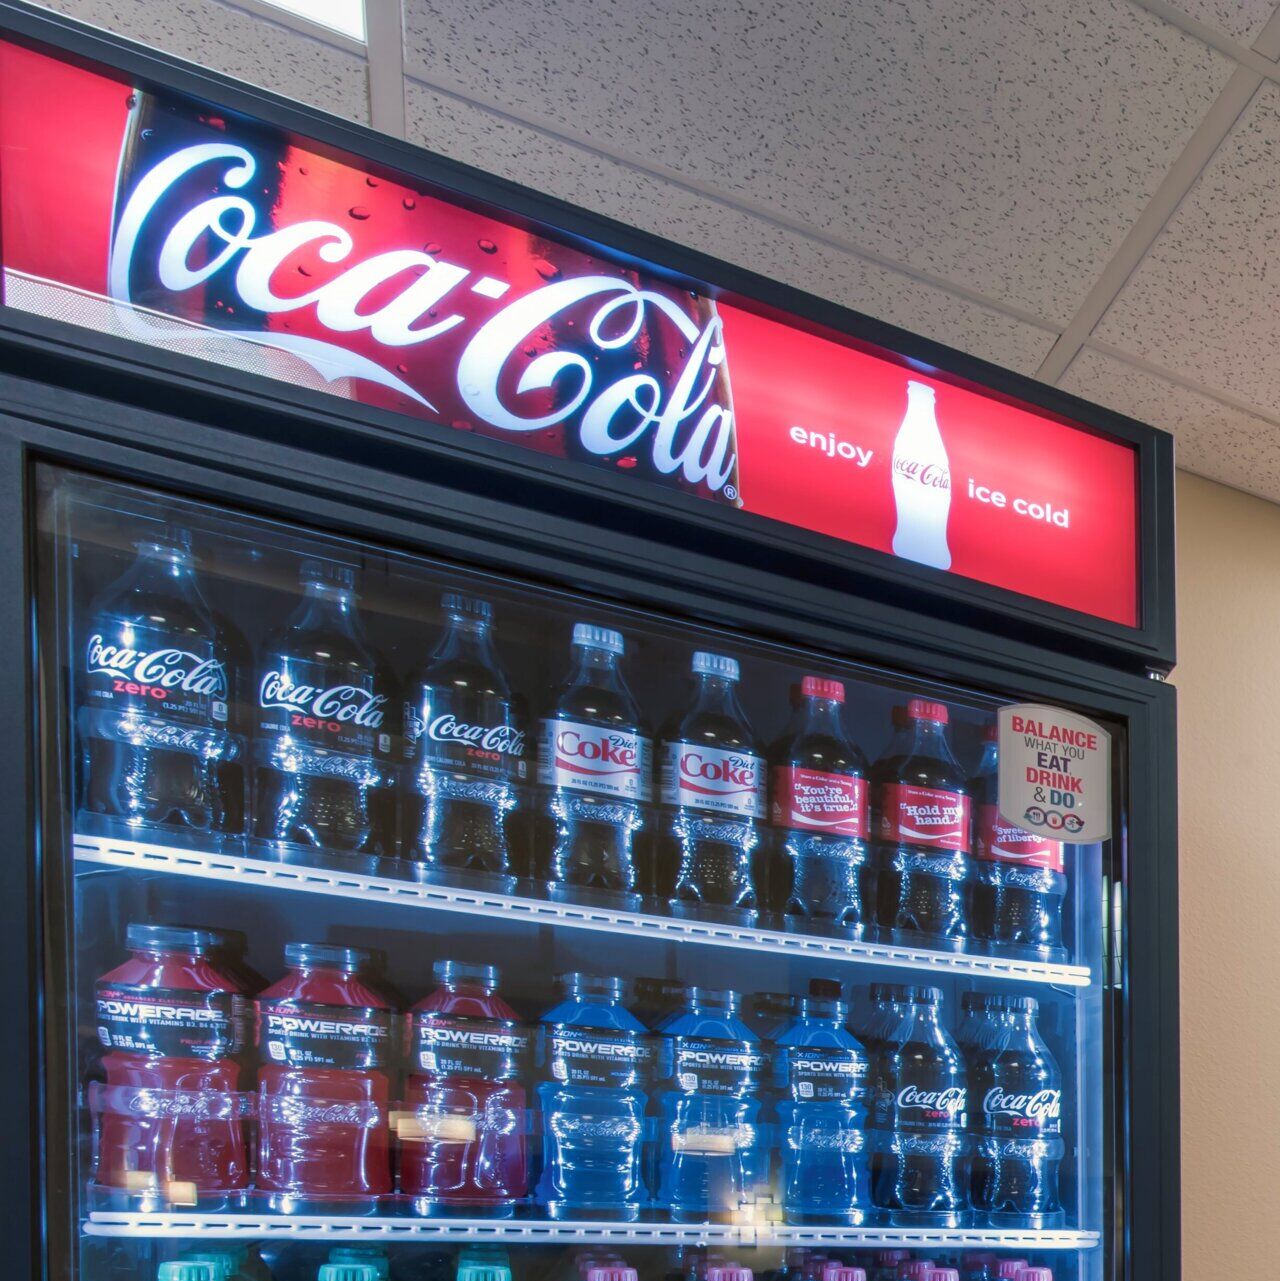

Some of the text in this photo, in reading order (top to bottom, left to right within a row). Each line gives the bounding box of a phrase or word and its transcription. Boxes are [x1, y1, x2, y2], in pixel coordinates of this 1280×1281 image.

[111, 143, 737, 492] Coca-Cola
[789, 426, 874, 467] enjoy
[967, 478, 1070, 529] ice cold
[87, 635, 227, 701] Coca-Cola
[113, 679, 168, 700] zero
[260, 671, 388, 729] Coca-Cola
[291, 714, 341, 733] zero
[428, 714, 526, 757] Coca-Cola
[1011, 715, 1098, 751] BALANCE
[466, 747, 501, 761] zero
[556, 731, 637, 768] Coke
[608, 735, 638, 750] Diet
[1024, 736, 1085, 761] WHAT YOU
[680, 753, 755, 786] Coke
[728, 755, 755, 770] Diet
[1026, 767, 1083, 793] DRINK
[1033, 786, 1075, 809] & DO
[97, 1000, 226, 1023] POWERADE
[149, 1018, 184, 1028] VITAMINS
[268, 1015, 388, 1037] POWERADE
[420, 1027, 528, 1047] POWERADE
[898, 1085, 967, 1111] Coca-Cola
[983, 1086, 1061, 1118] Coca-Cola
[924, 1109, 951, 1118] zero
